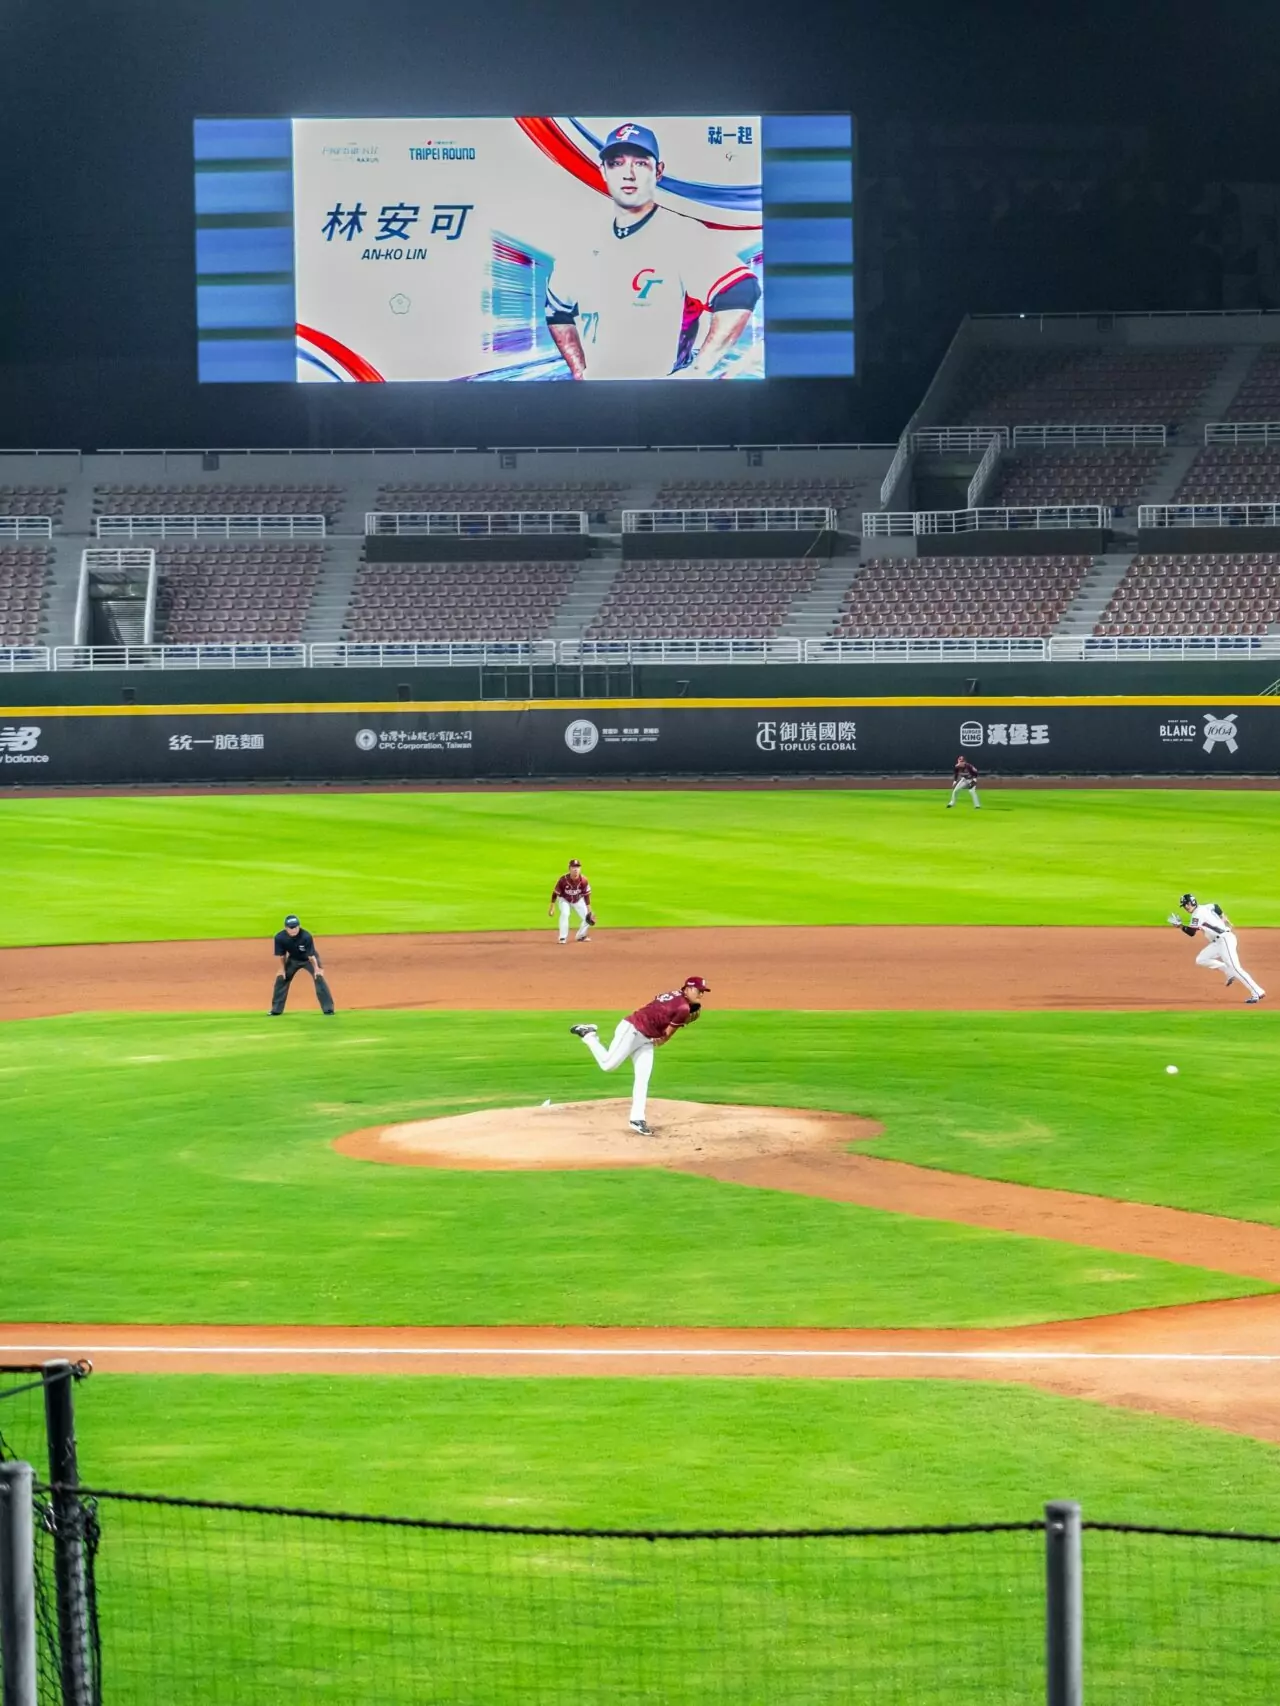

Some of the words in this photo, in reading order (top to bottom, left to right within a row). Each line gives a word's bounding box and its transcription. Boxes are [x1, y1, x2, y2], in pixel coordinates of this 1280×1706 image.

[708, 126, 752, 144] 就一起
[409, 148, 440, 160] TAIPEI
[443, 148, 475, 160] ROUND
[321, 202, 474, 241] 林安可
[361, 249, 403, 260] AN-KO
[406, 249, 427, 260] LIN
[1160, 725, 1196, 737] BLANC
[780, 743, 816, 751] TOPLUS
[819, 743, 857, 751] GLOBAL
[5, 754, 49, 763] balance
